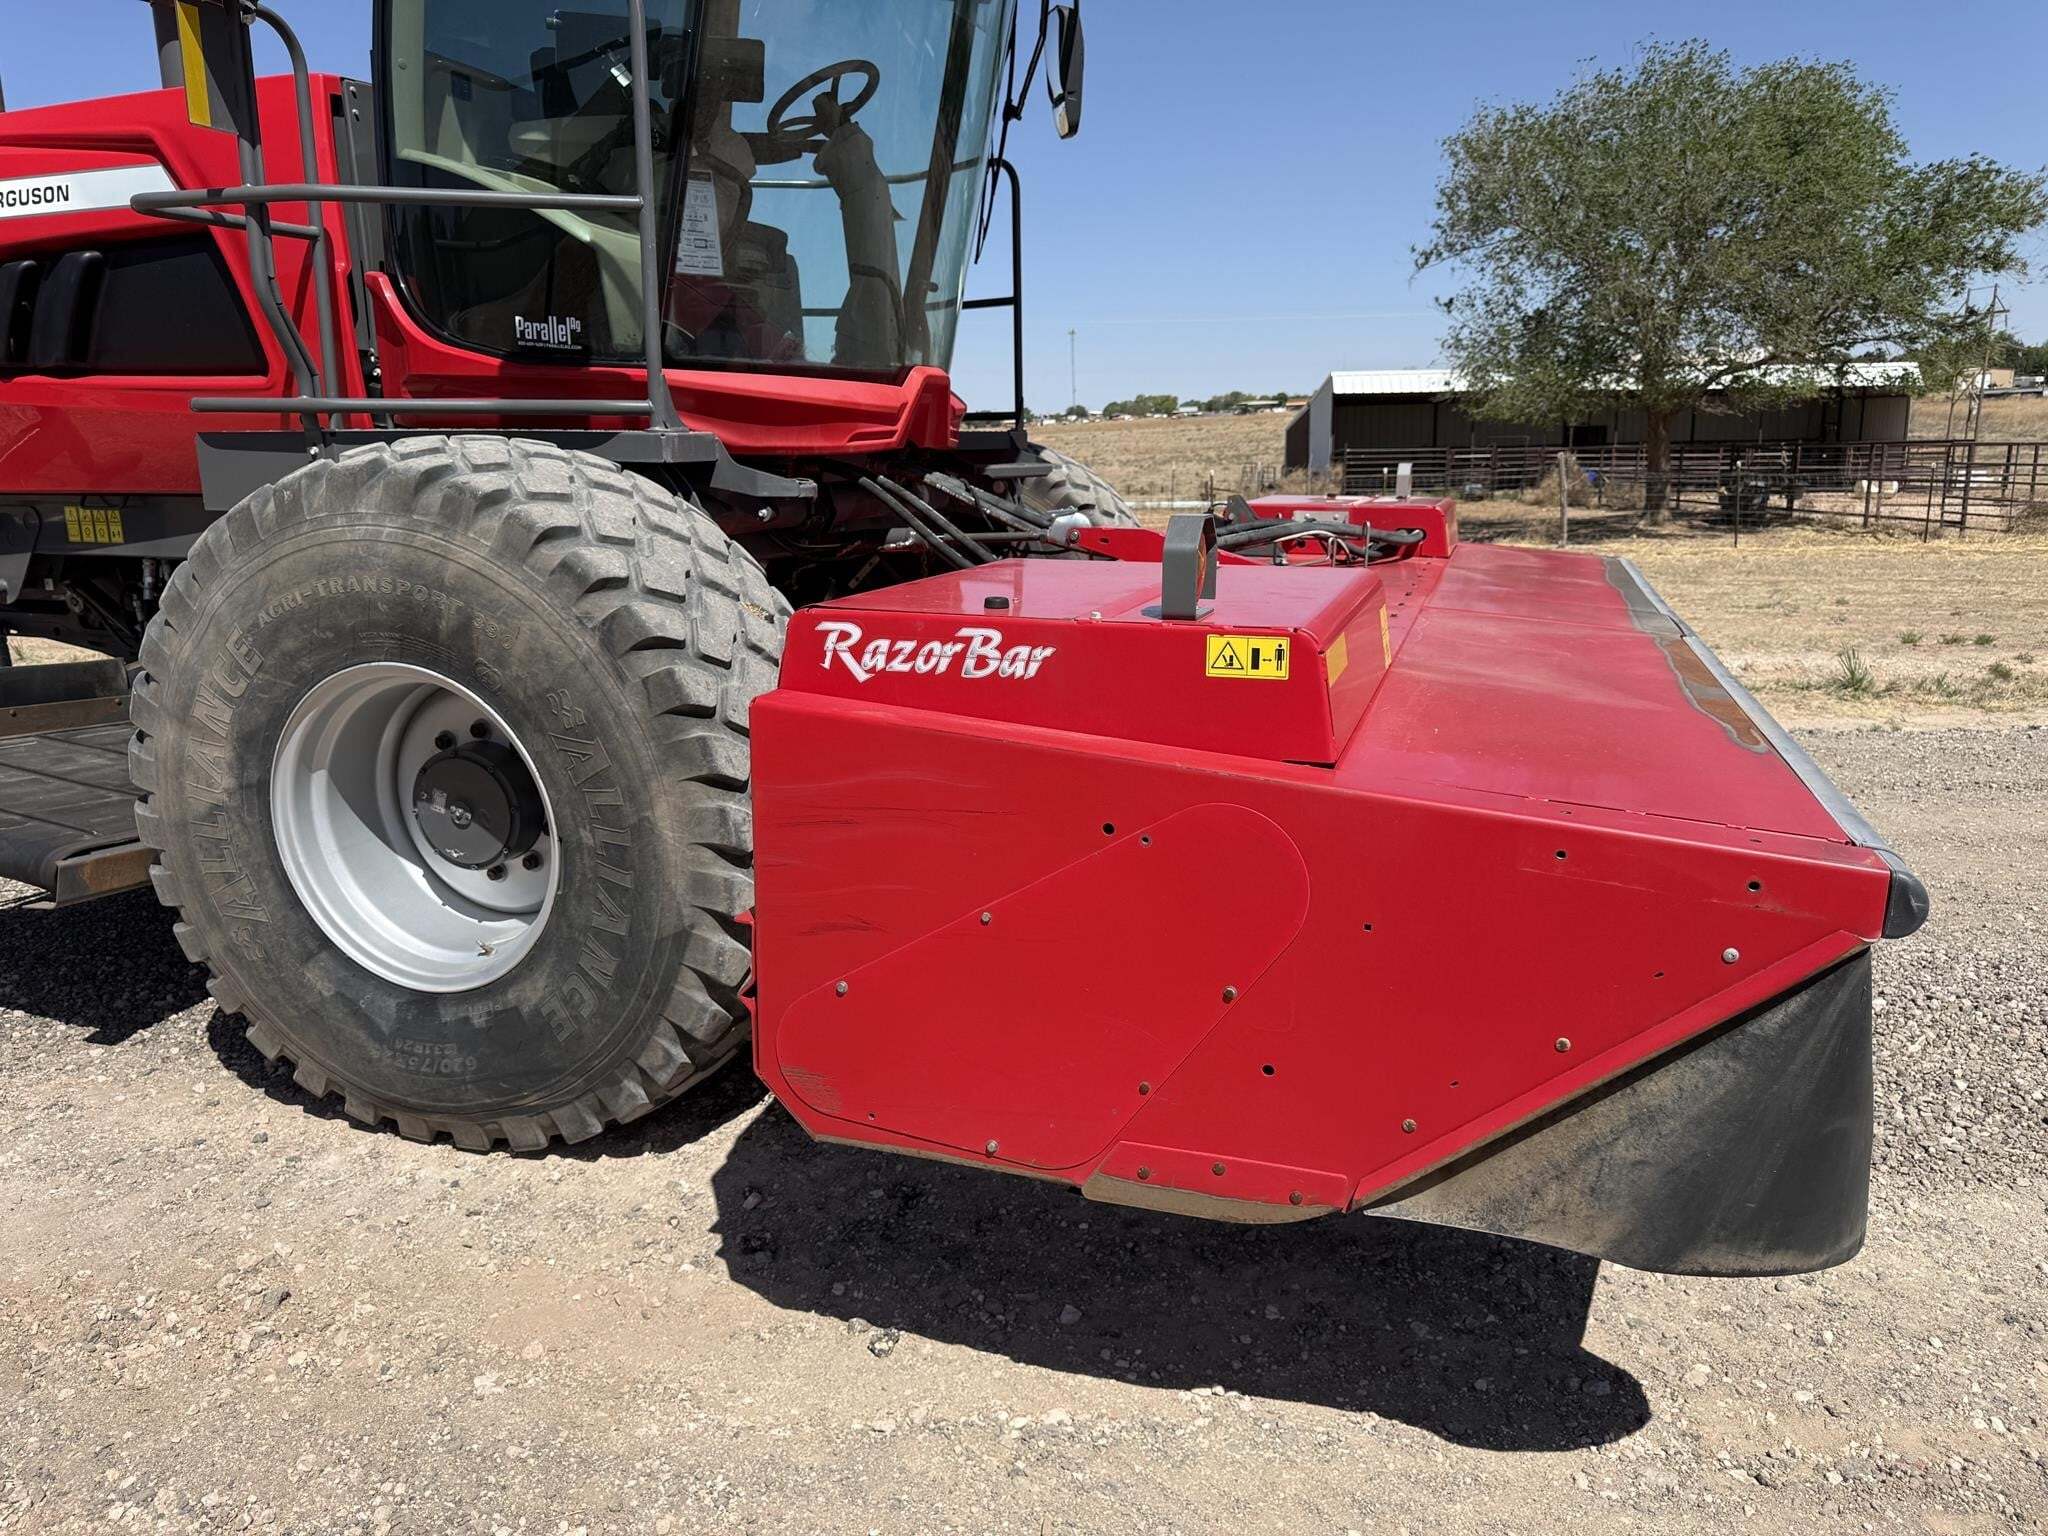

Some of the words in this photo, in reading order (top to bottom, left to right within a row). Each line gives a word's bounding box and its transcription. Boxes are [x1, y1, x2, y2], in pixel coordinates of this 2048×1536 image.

[257, 574, 464, 629] AGRI-TRANSPORT
[815, 621, 1056, 683] RazorBar
[186, 624, 272, 923] ALLIANCE
[541, 731, 633, 1042] ALLIANCE
